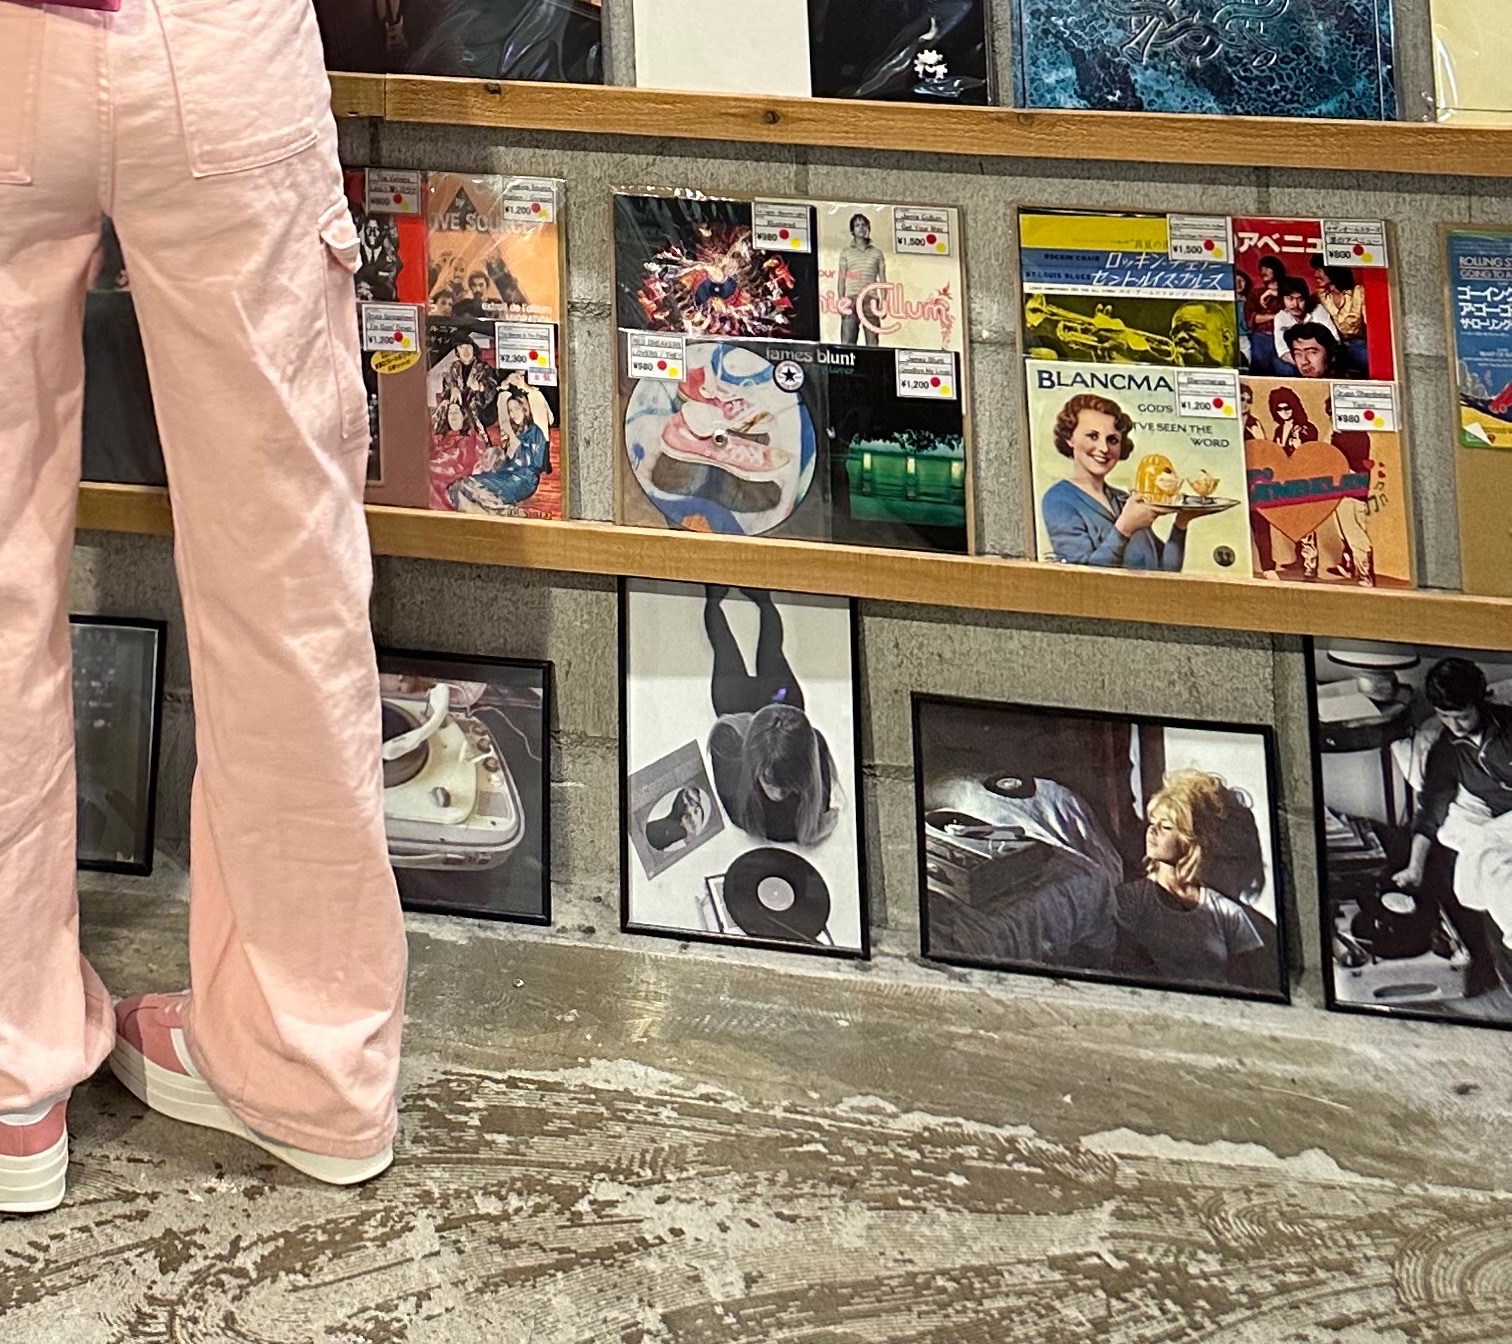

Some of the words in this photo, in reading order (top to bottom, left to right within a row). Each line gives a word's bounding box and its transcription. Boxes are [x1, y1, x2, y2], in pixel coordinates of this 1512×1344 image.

[817, 347, 856, 367] blunt
[1036, 368, 1175, 393] BLANCMA
[1189, 423, 1213, 434] THE
[1190, 436, 1230, 448] WORD
